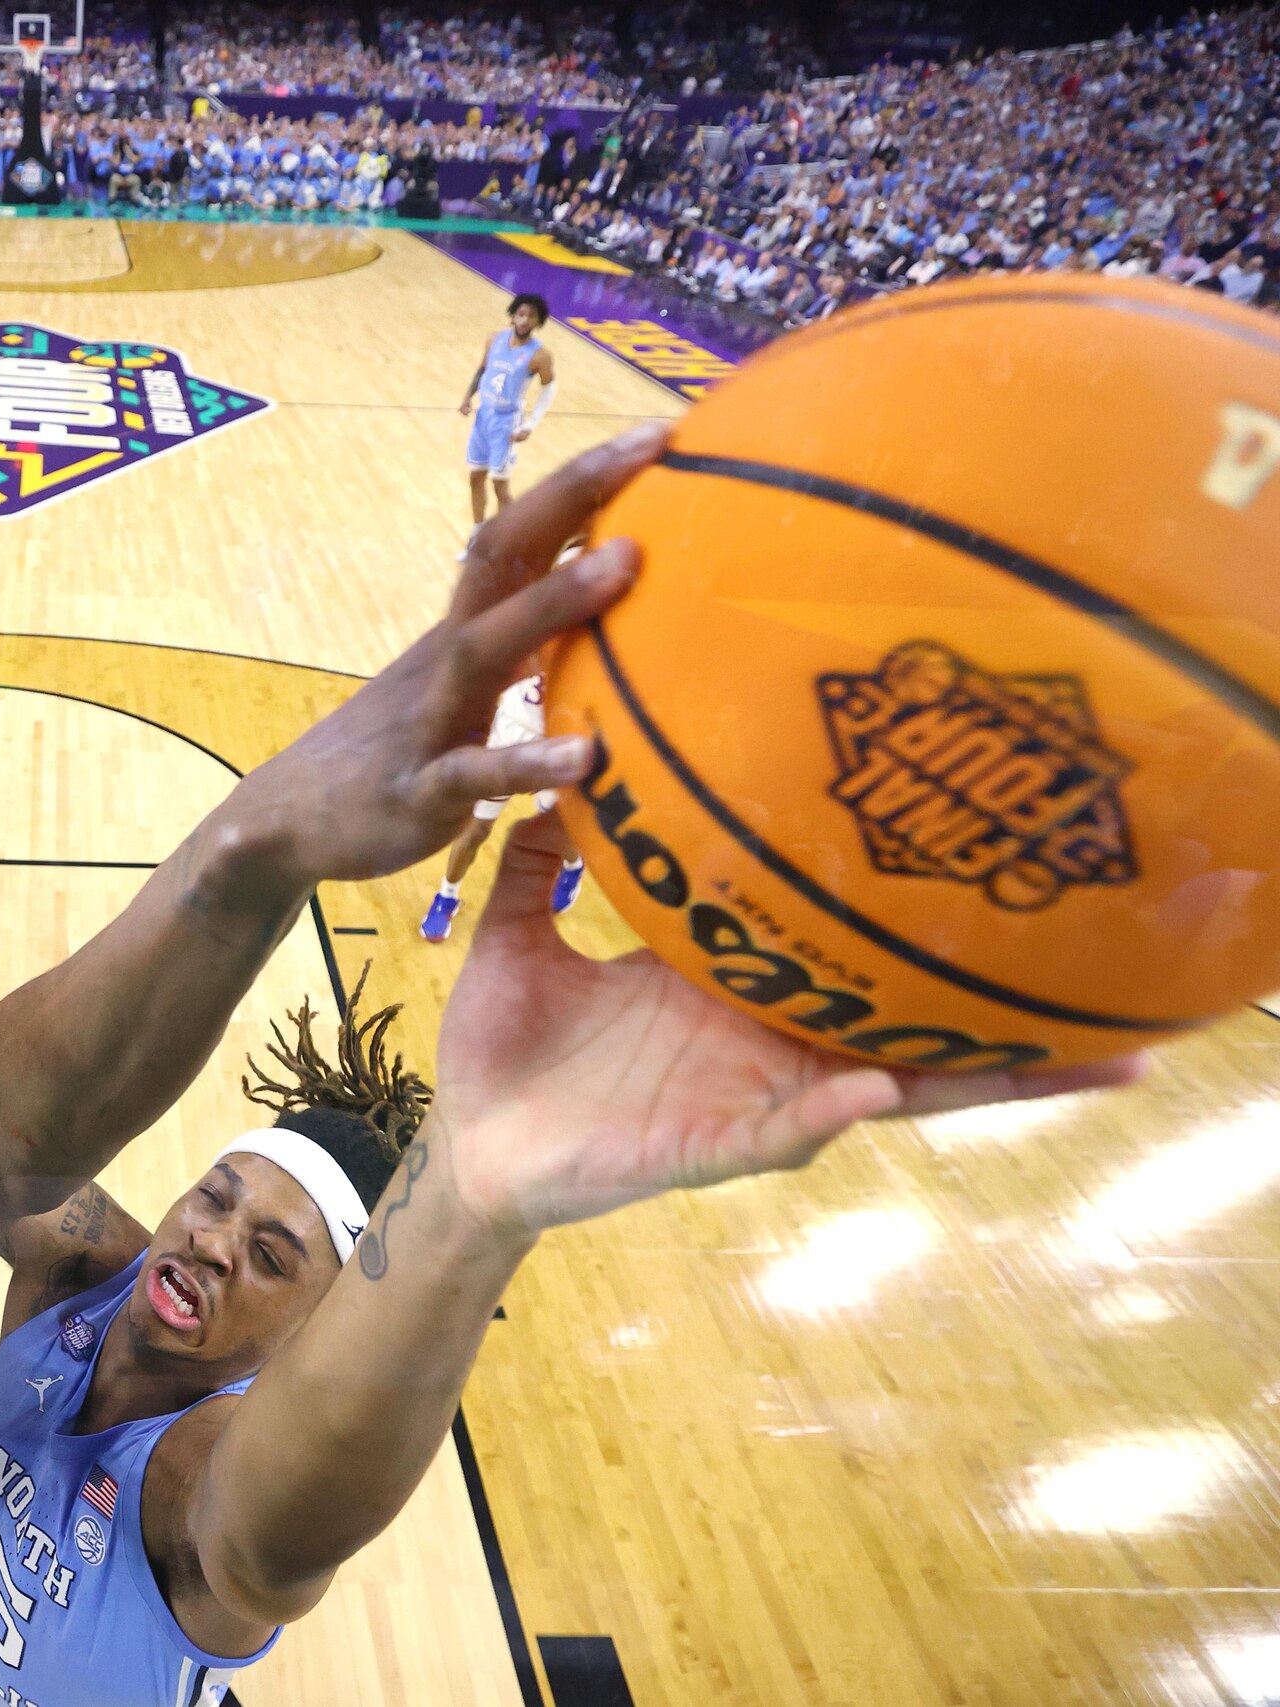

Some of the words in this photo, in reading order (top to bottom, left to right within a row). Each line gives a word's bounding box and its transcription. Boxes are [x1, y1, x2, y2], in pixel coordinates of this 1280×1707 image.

[874, 698, 1113, 838] FOUR
[830, 746, 1021, 878] FINAL
[710, 878, 785, 936] NXT
[792, 938, 875, 990] EVO
[66, 1328, 85, 1350] FOUR
[74, 1324, 93, 1348] FINAL
[78, 1530, 105, 1552] ACC
